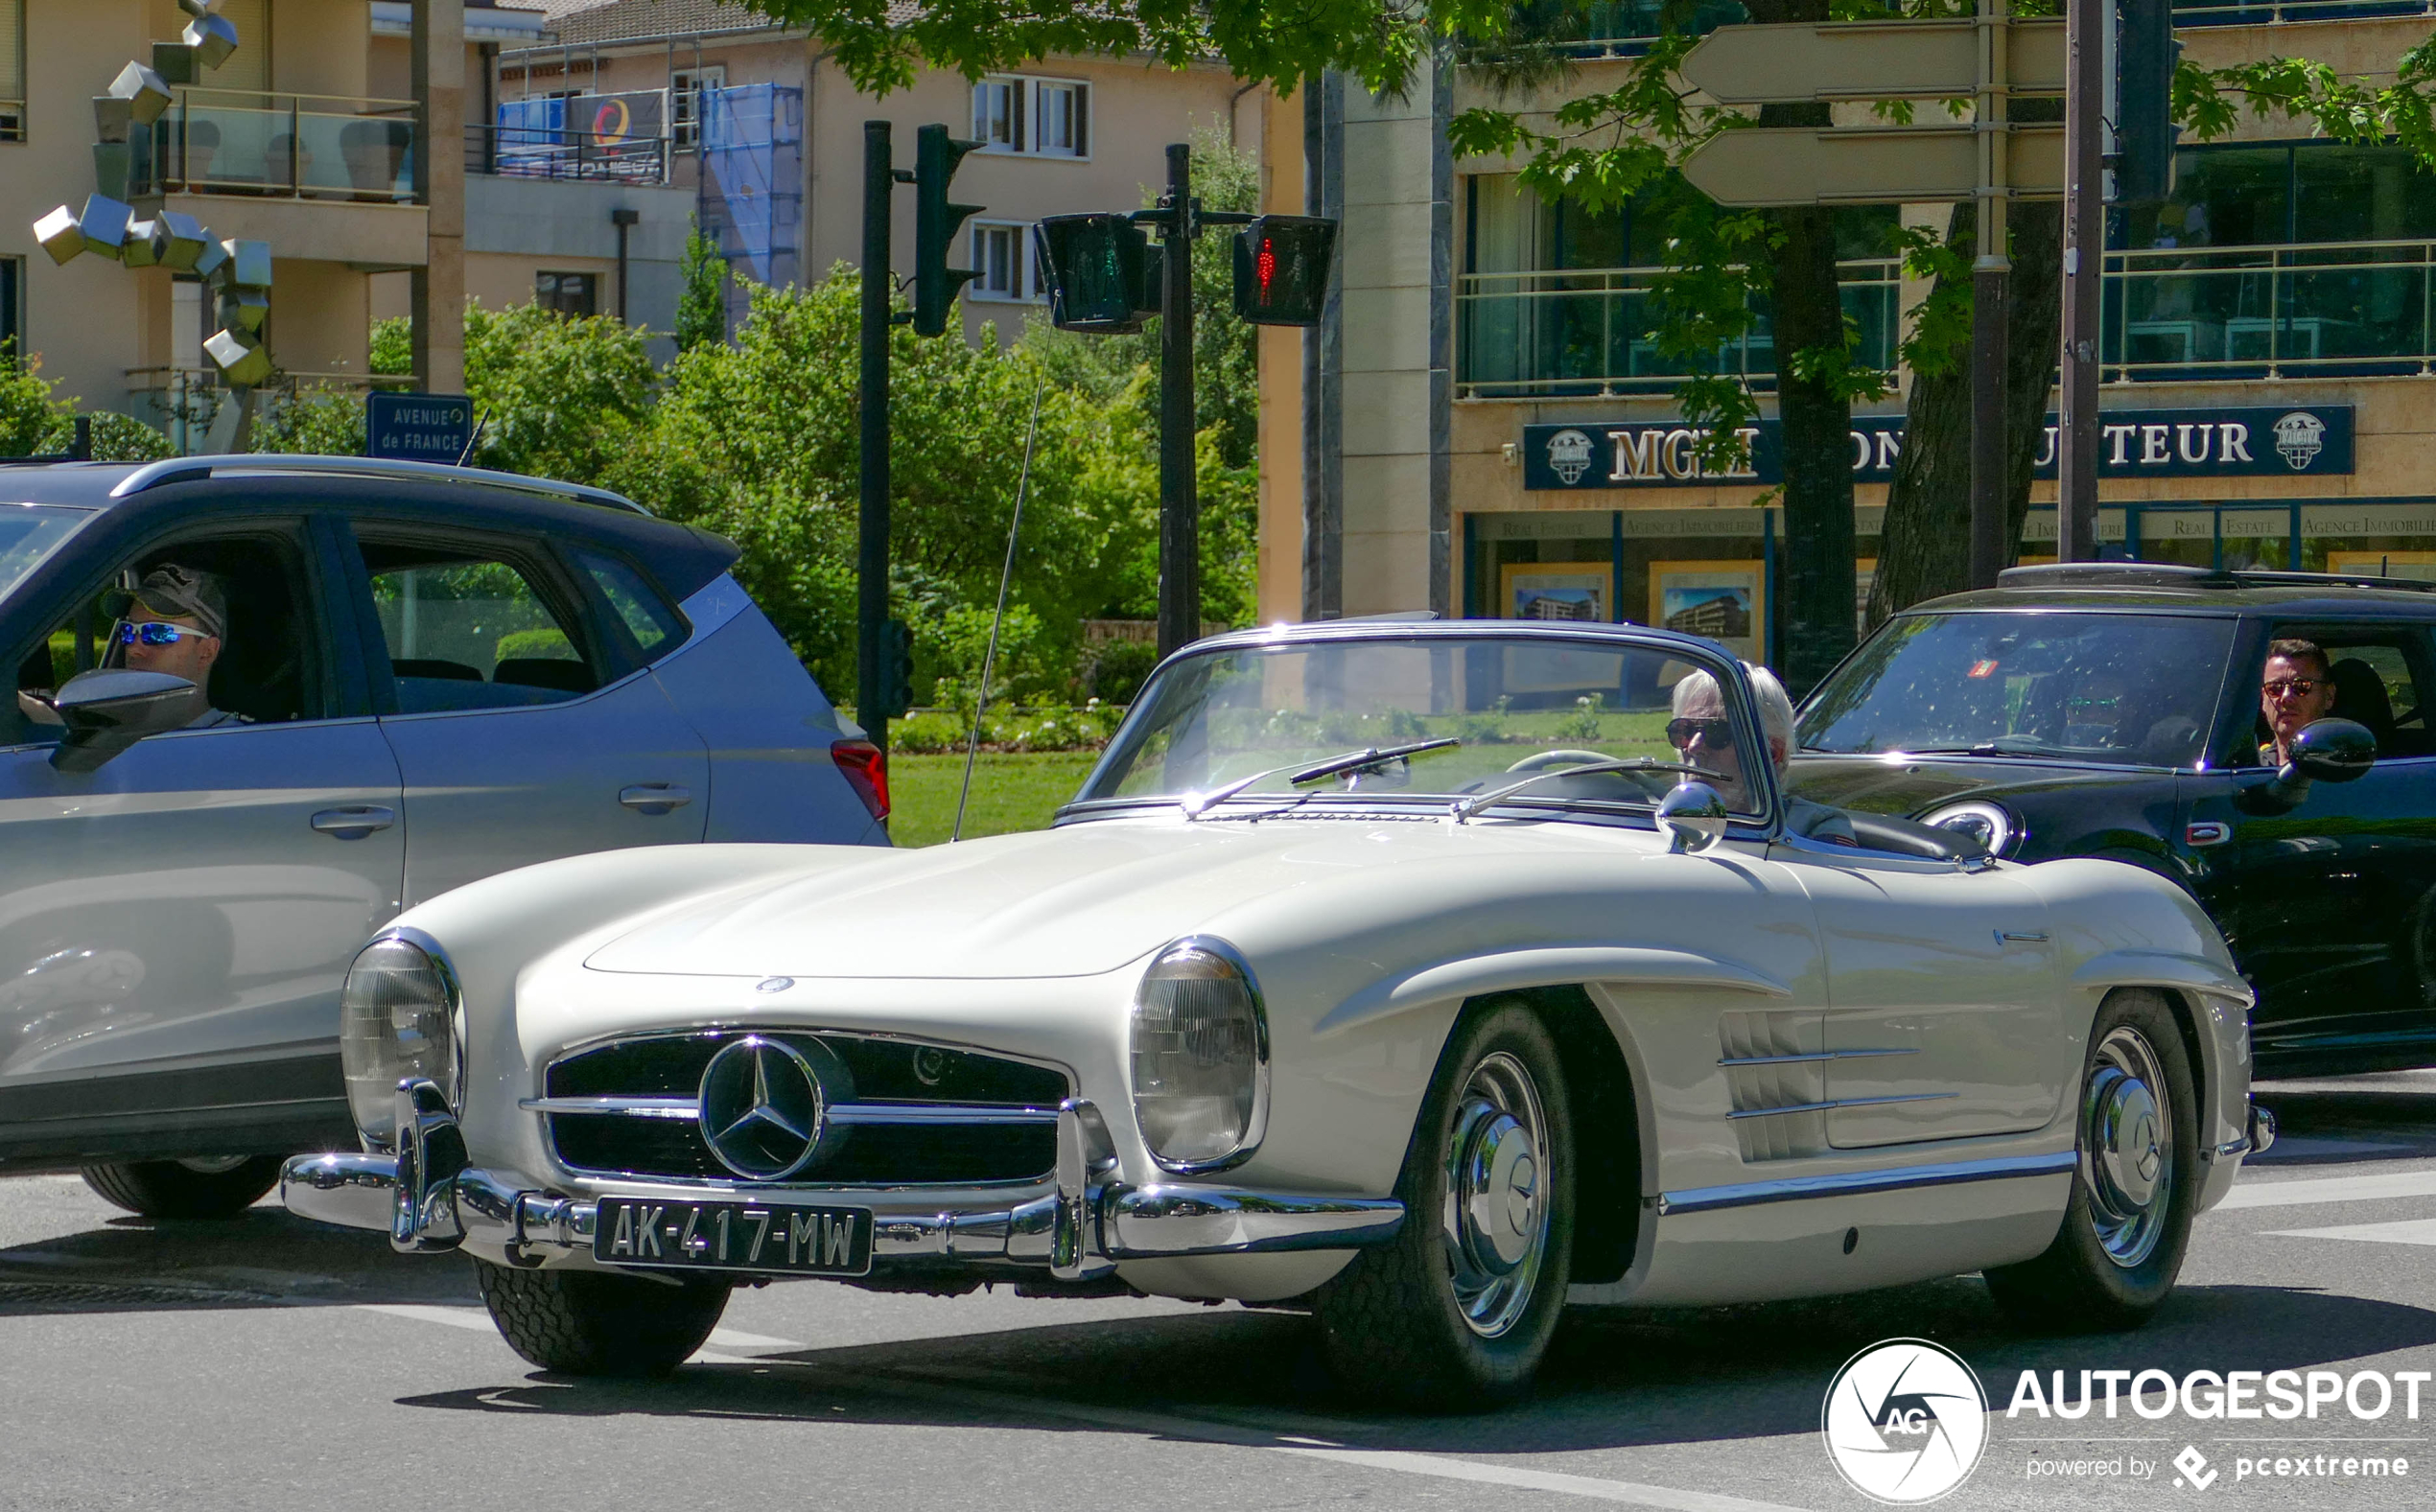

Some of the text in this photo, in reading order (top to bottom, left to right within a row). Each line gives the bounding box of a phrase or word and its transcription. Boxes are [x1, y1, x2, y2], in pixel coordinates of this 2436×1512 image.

[394, 408, 448, 425] AVENUE
[382, 432, 460, 451] de FRANCE
[2303, 518, 2359, 533] AGENCE
[611, 1204, 855, 1266] AK-417-MW
